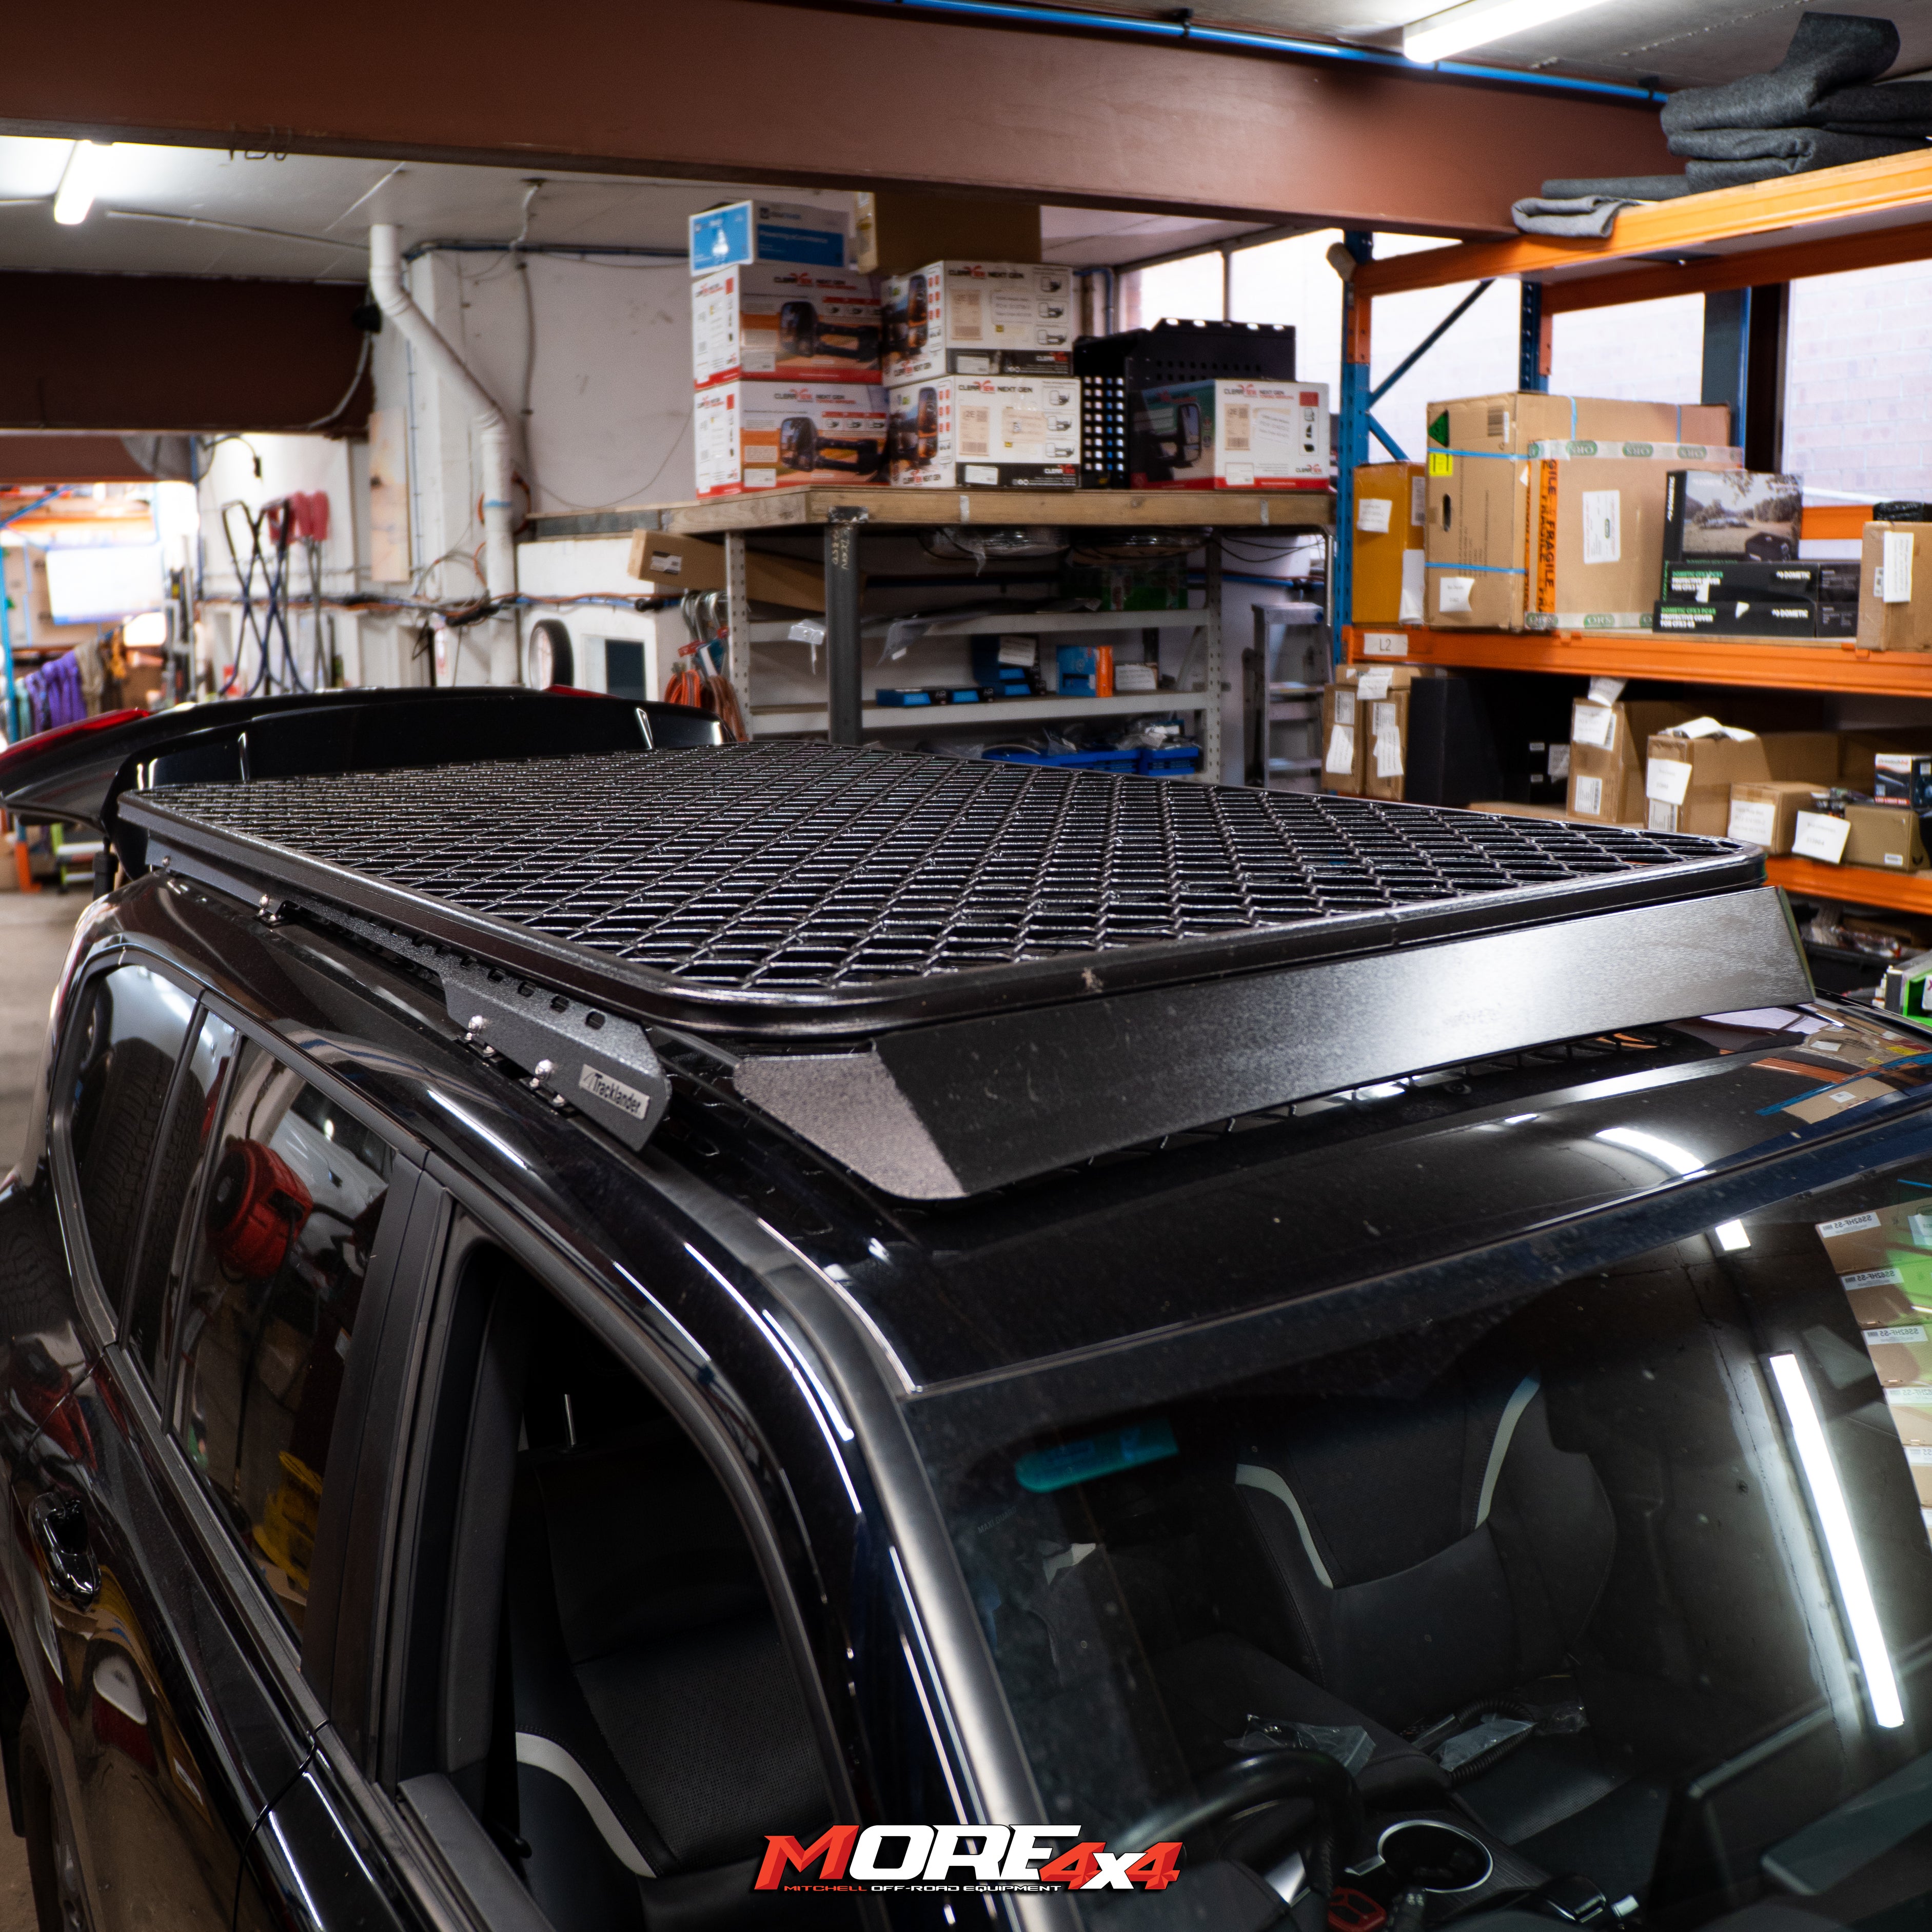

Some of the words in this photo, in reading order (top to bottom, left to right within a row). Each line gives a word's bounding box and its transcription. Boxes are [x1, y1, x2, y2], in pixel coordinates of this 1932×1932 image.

[1545, 519, 1555, 588] FRAGILE
[1784, 571, 1811, 580] DOMETIC
[1780, 609, 1809, 618] DOMETIC
[1379, 638, 1391, 651] L2
[595, 1073, 641, 1113] Tracklander
[977, 1519, 994, 1534] MAXI
[996, 1506, 1017, 1524] GUARD
